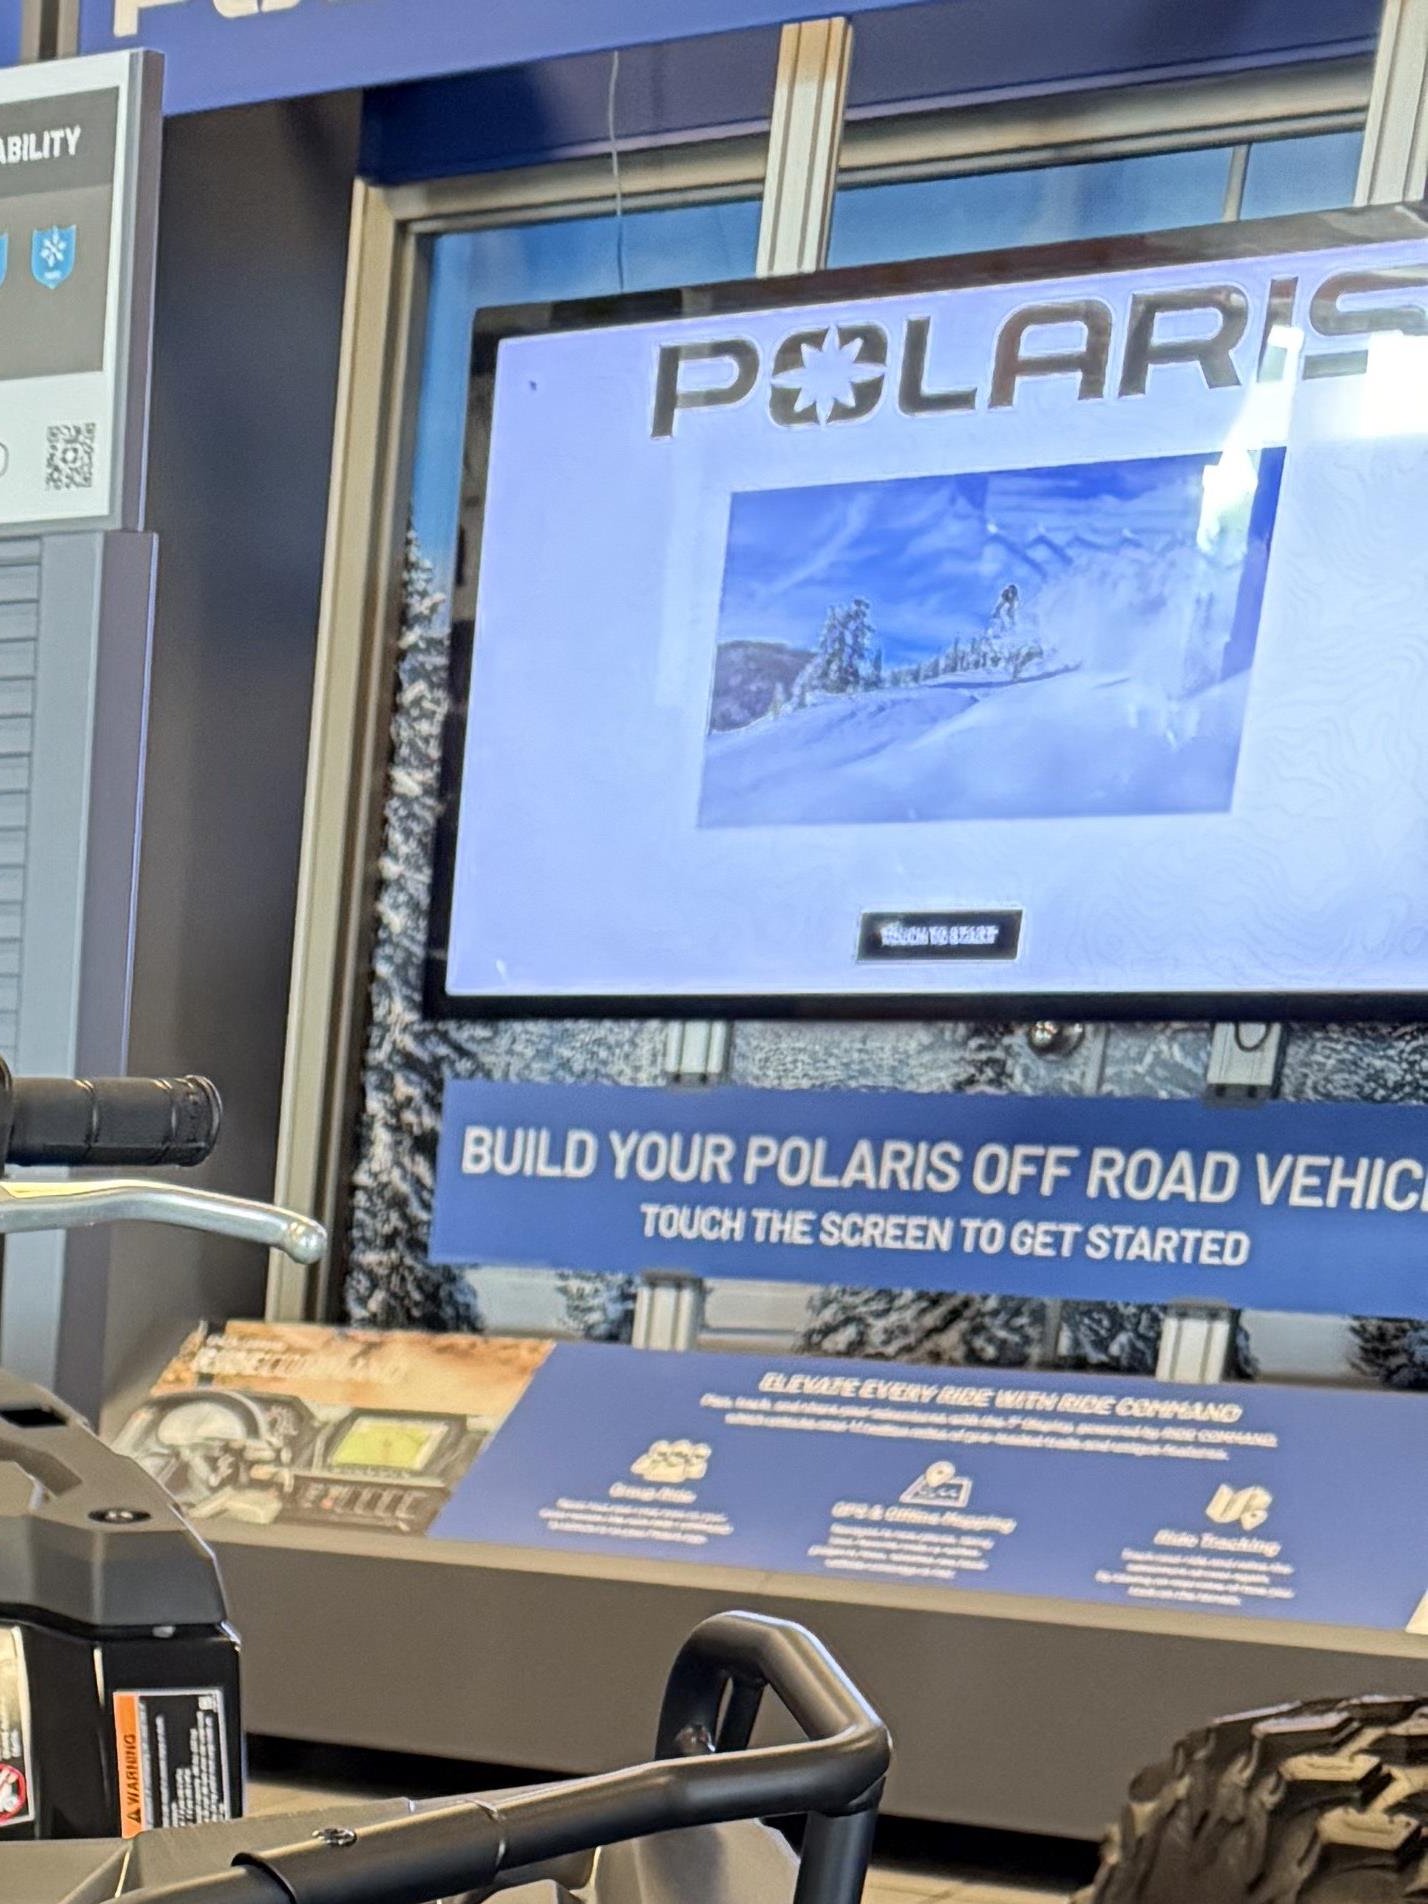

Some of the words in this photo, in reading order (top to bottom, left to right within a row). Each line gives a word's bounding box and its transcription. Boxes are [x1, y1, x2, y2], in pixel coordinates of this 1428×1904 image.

[460, 1124, 598, 1178] BUILD
[609, 1129, 735, 1185] YOUR
[744, 1135, 963, 1195] POLARIS
[972, 1143, 1082, 1197] OFF
[1087, 1146, 1240, 1204] ROAD
[1256, 1152, 1428, 1212] VEHIC
[641, 1203, 744, 1243] TOUCH
[751, 1207, 816, 1246] THE
[819, 1210, 954, 1253] SCREEN
[960, 1218, 1005, 1255] TO
[1010, 1221, 1083, 1259] GET
[1085, 1223, 1251, 1267] STARTED
[859, 1377, 937, 1403] EVERY
[936, 1383, 995, 1407] RIDE
[995, 1388, 1057, 1411] WITH
[1057, 1392, 1117, 1416] RIDE
[1115, 1396, 1243, 1424] COMMAND
[125, 1733, 141, 1807] WARNING
